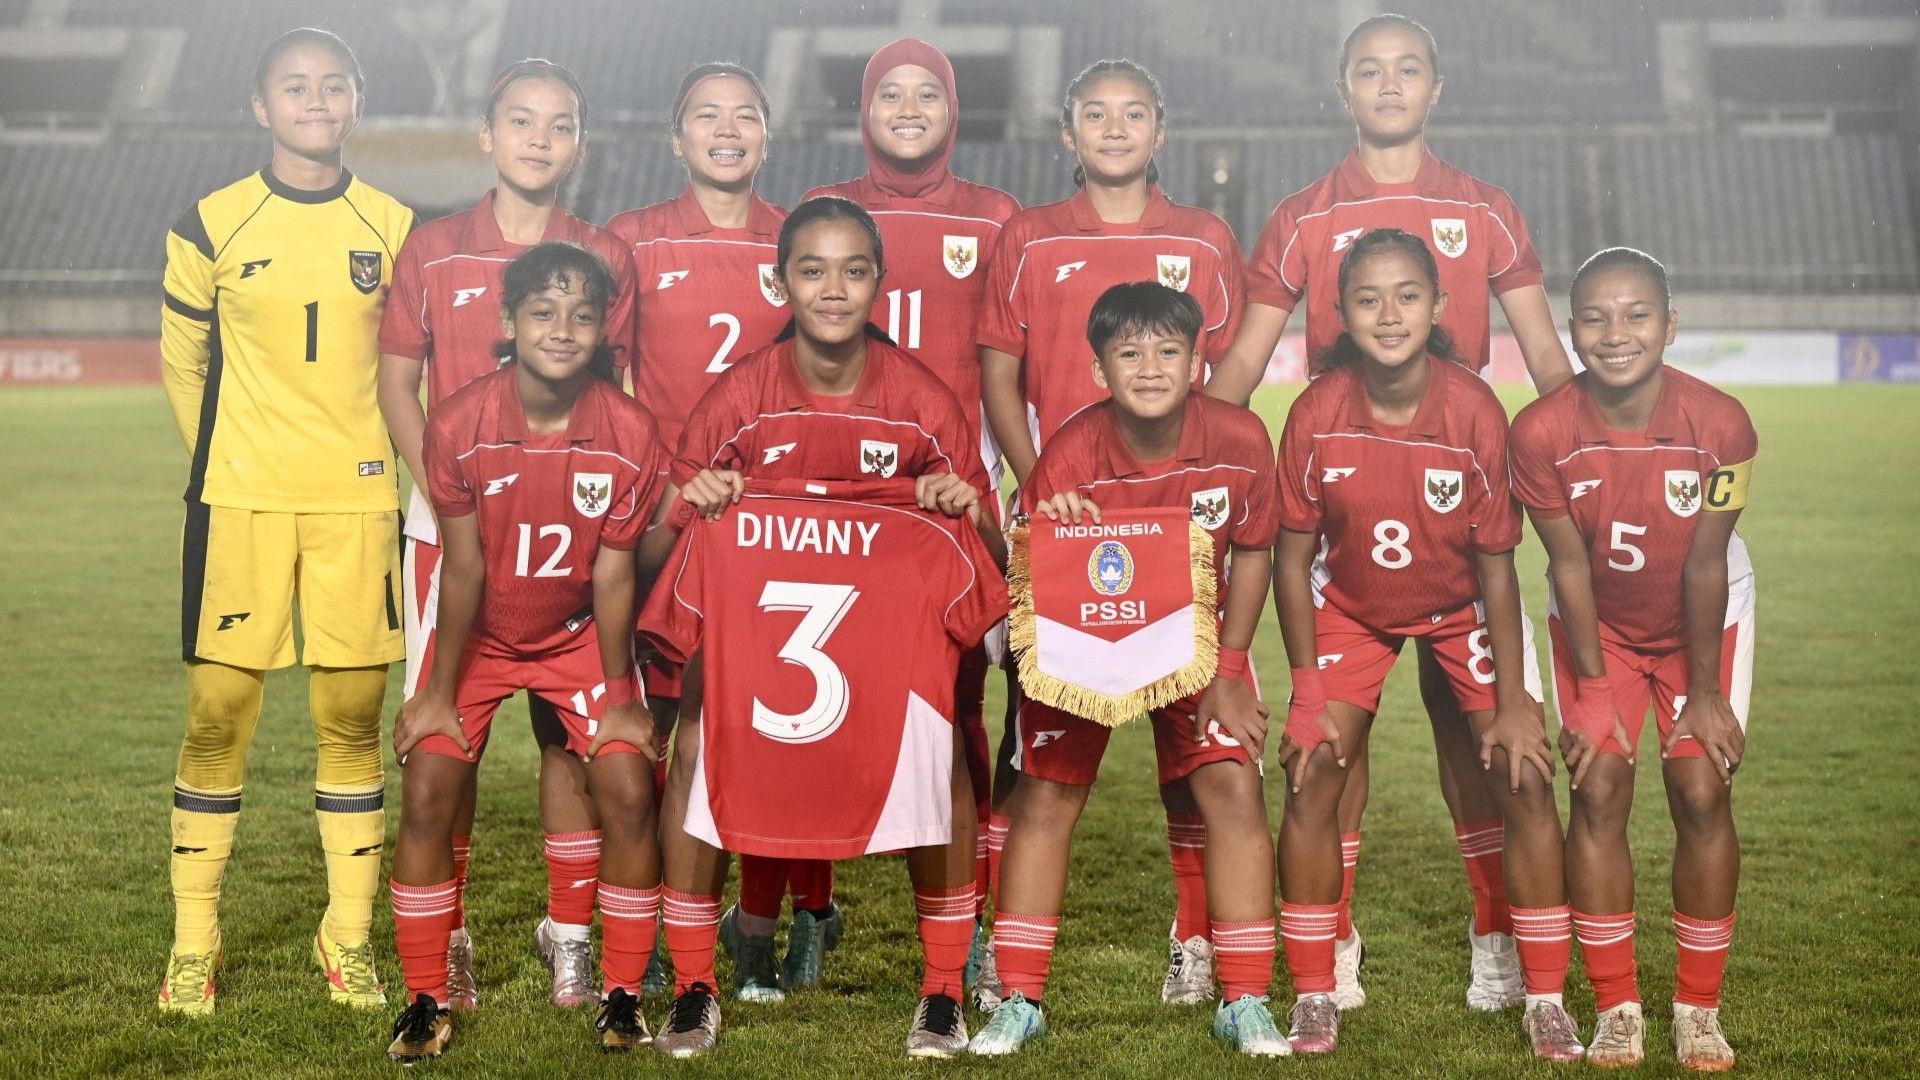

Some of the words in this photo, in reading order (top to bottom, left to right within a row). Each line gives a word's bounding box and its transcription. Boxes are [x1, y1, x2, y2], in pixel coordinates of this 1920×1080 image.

[303, 301, 319, 362] 1
[704, 312, 741, 374] 2
[886, 288, 922, 349] 11
[1707, 470, 1735, 508] C
[515, 523, 574, 578] 12
[736, 511, 882, 557] DIVANY
[1055, 523, 1164, 539] INDONESIA
[1371, 519, 1413, 570] 8
[1608, 521, 1648, 573] 5
[384, 569, 400, 631] 1
[1080, 600, 1147, 622] PSSI
[751, 580, 862, 745] 3
